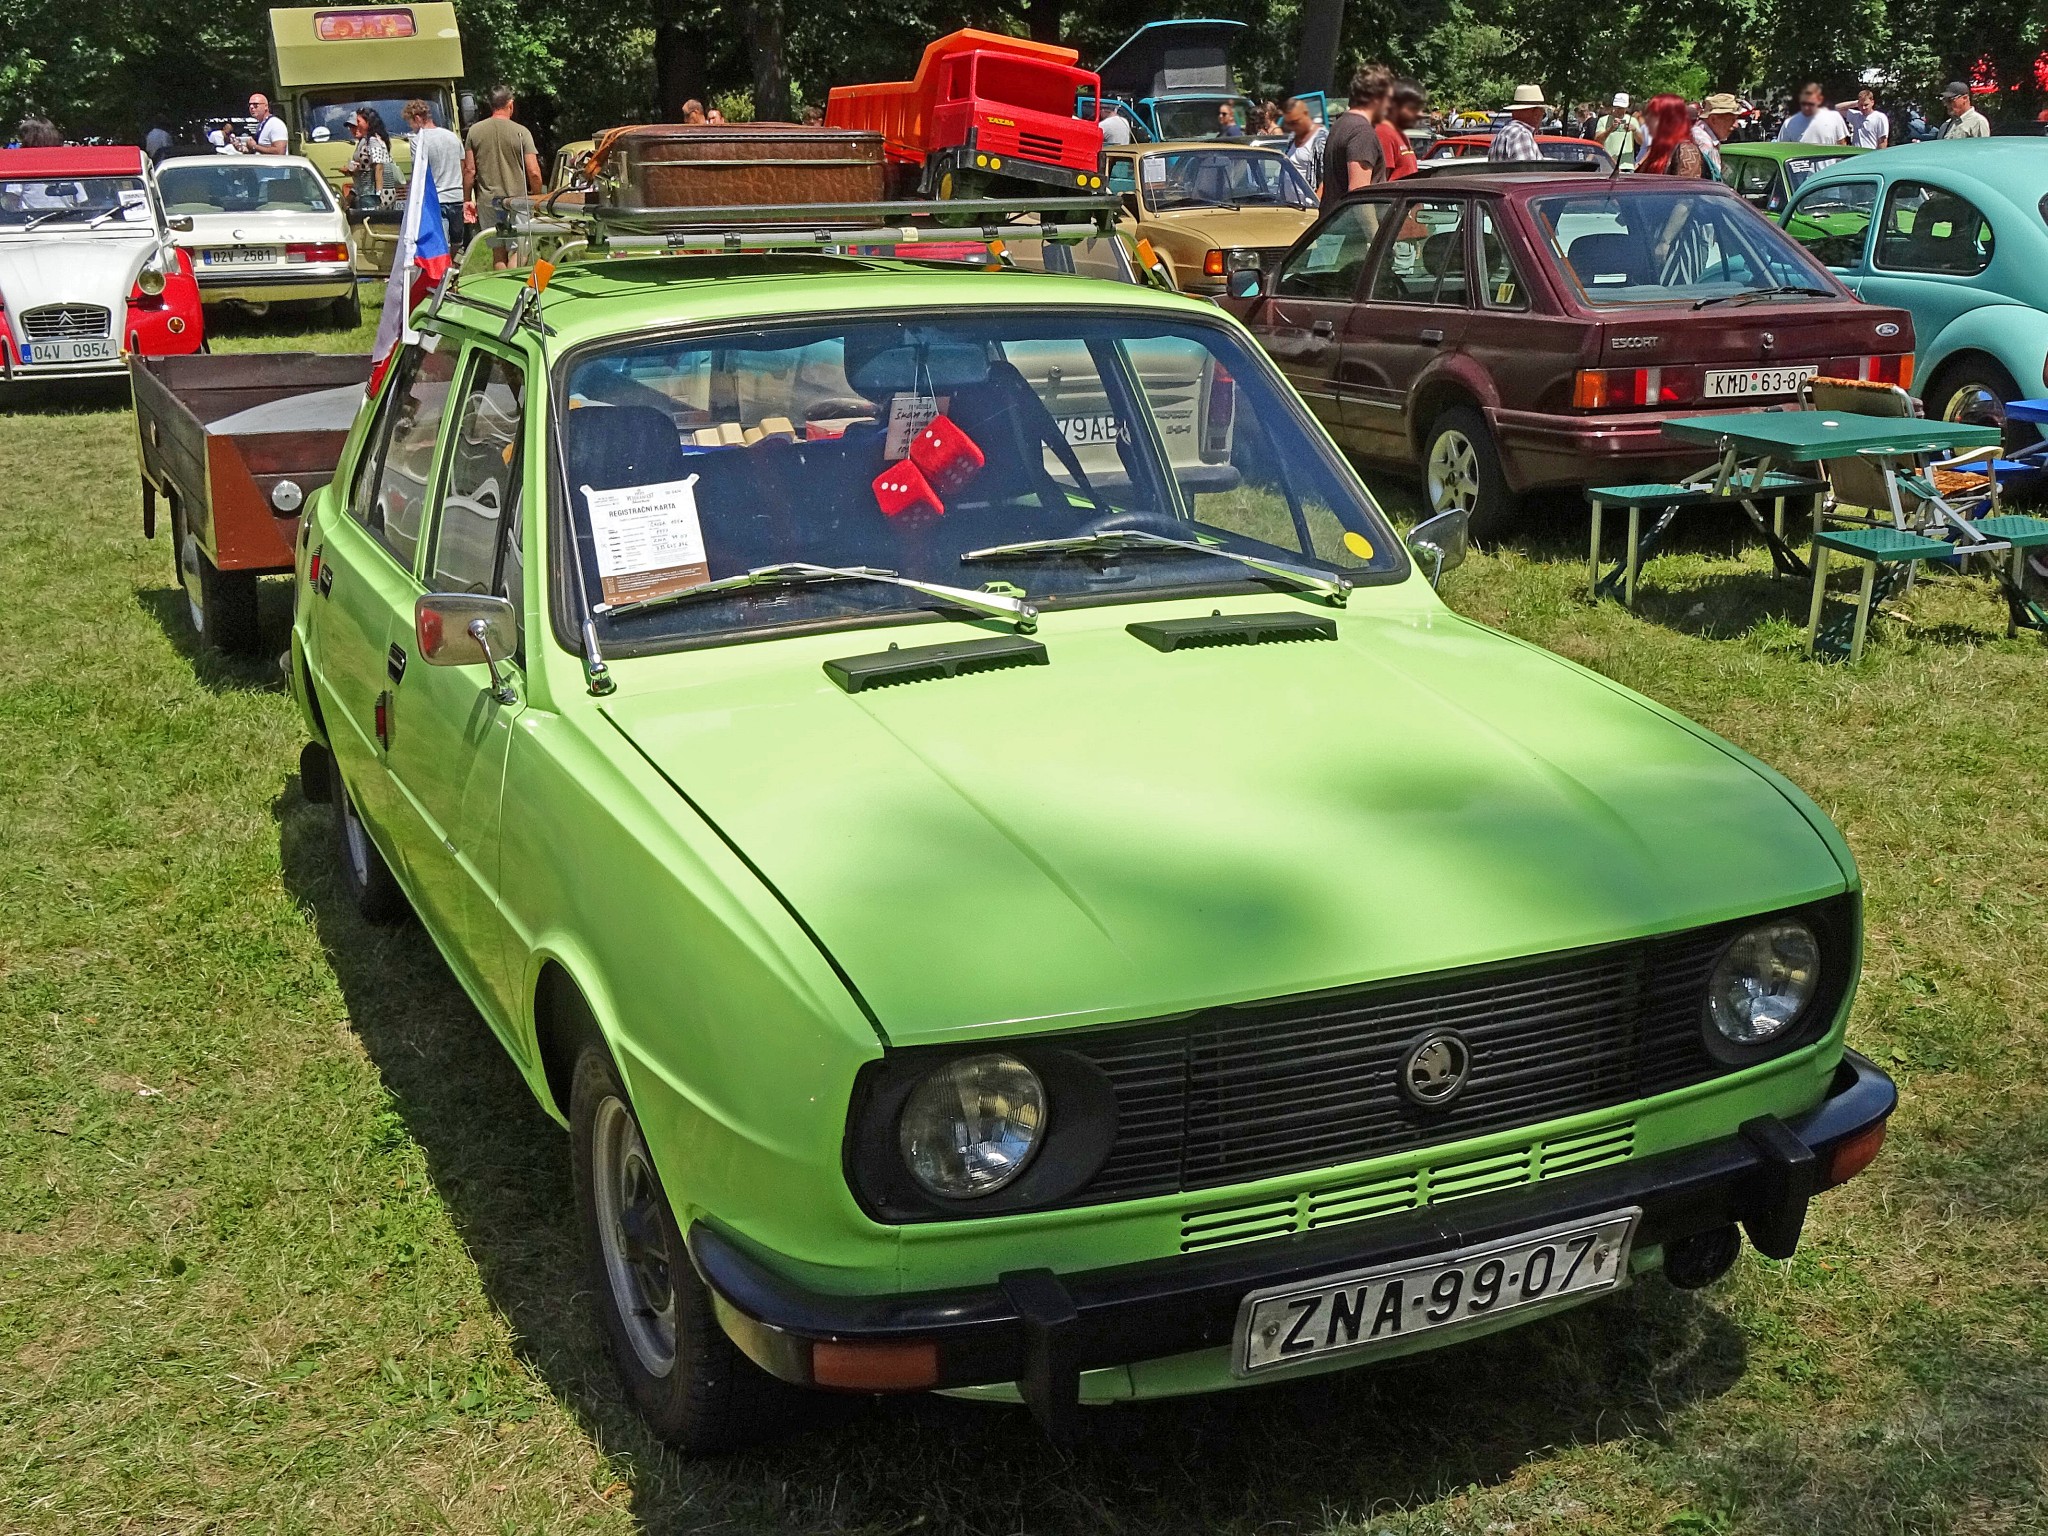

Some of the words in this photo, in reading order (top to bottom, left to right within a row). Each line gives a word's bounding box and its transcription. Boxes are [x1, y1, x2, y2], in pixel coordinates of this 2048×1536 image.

[987, 117, 1015, 127] TATRA
[213, 251, 234, 263] 02V
[1611, 336, 1659, 349] ESCORT
[33, 345, 60, 360] 04V
[73, 342, 110, 357] 0954
[1715, 374, 1748, 395] KMD
[608, 505, 653, 518] REGISTRAČNÍ
[654, 503, 676, 512] KARTA
